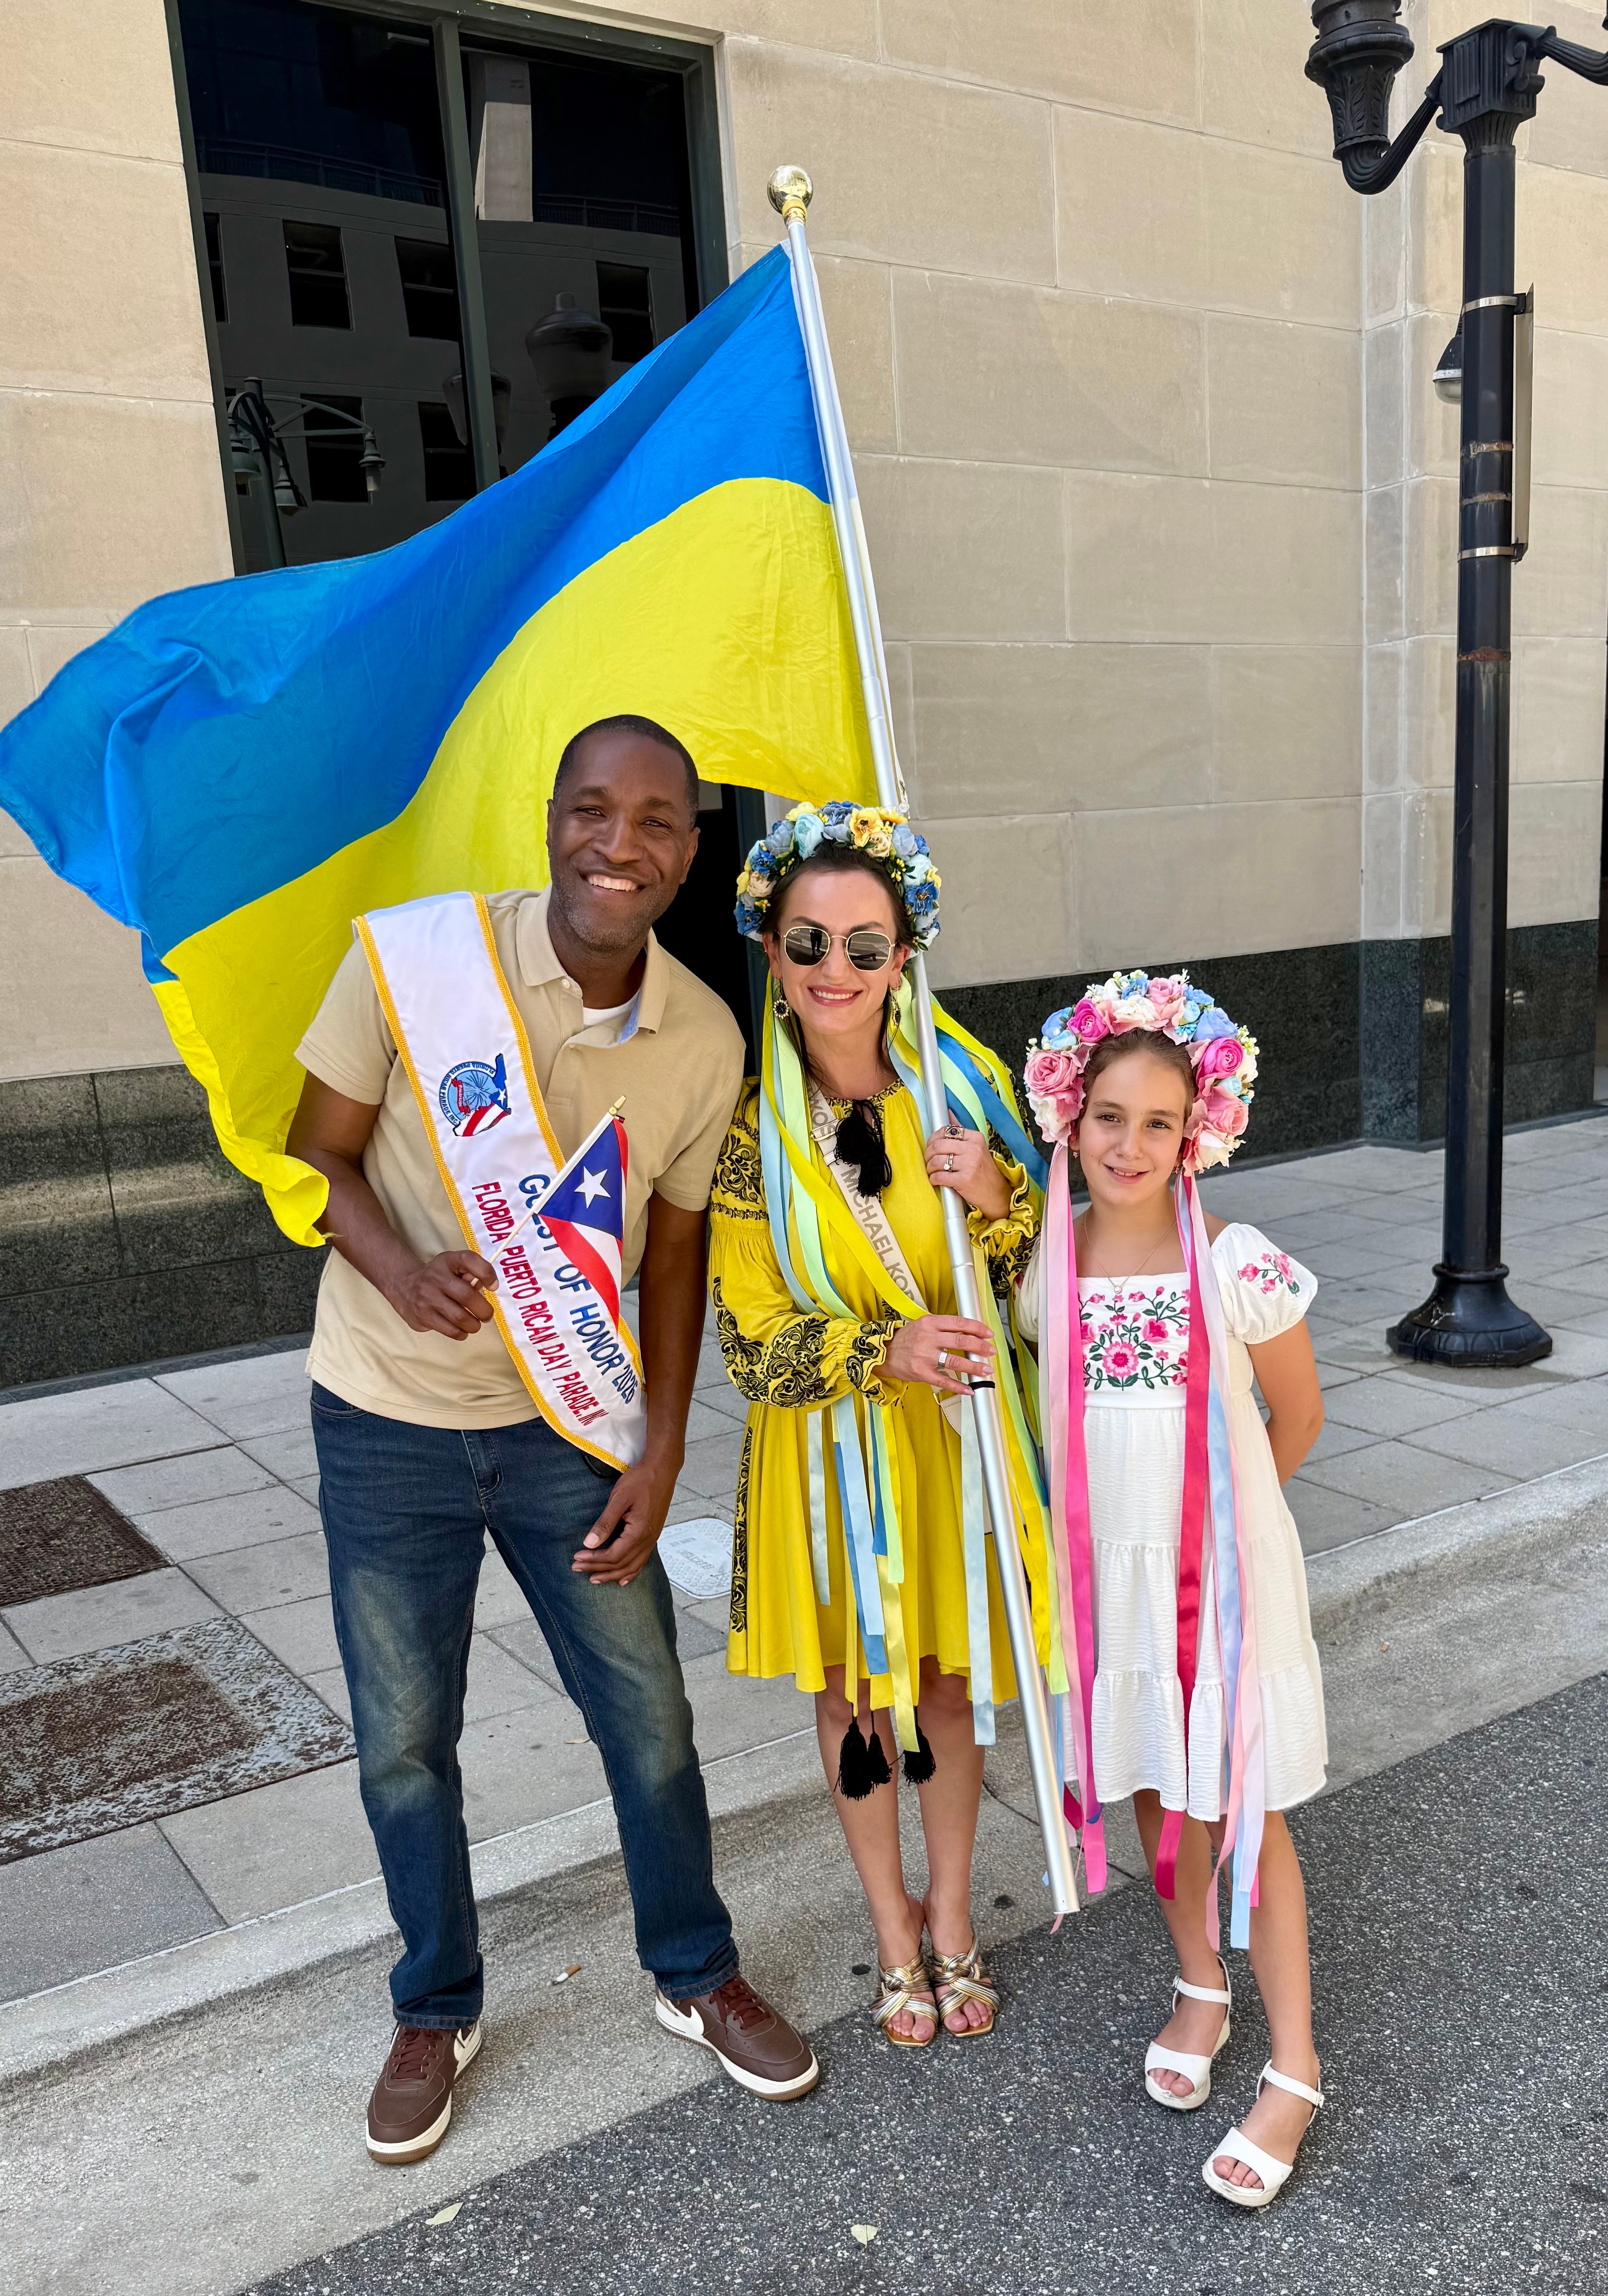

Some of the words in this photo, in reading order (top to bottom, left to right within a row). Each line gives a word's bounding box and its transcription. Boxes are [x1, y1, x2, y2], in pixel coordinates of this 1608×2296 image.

[471, 1181, 518, 1244] FLORIDA
[840, 1167, 894, 1263] MICHAEL
[499, 1245, 542, 1300] PUERTO
[554, 1264, 592, 1292] OF
[519, 1300, 560, 1346] RICAN
[570, 1302, 625, 1376] HONOR
[537, 1343, 572, 1371] DAY
[612, 1363, 638, 1404] 2026
